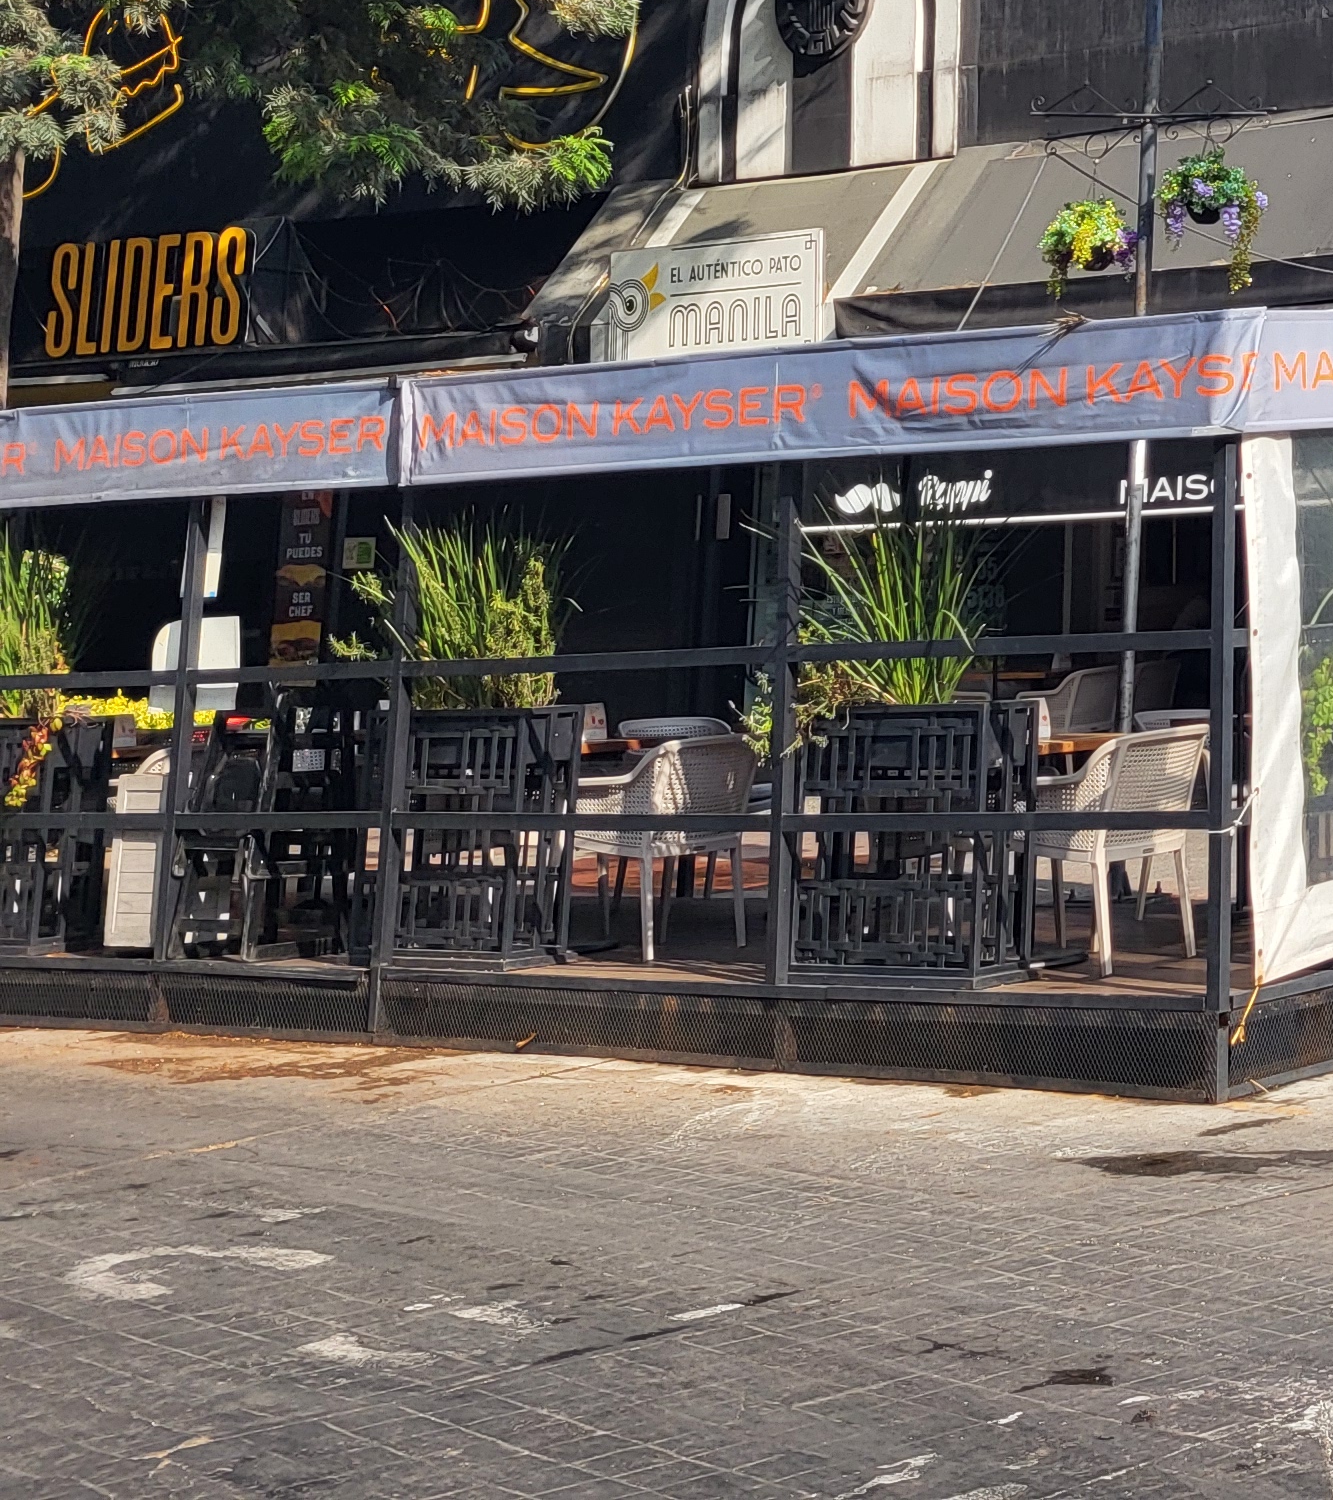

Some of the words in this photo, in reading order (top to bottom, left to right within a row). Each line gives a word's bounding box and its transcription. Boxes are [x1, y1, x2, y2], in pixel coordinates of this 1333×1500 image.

[45, 226, 247, 358] SLIDERS
[670, 266, 684, 284] EL
[688, 258, 764, 284] AUTÉNTICO
[768, 254, 802, 274] PATO
[668, 293, 801, 348] MANILA
[848, 366, 1068, 419] MAISON
[53, 426, 209, 474] MAISON
[220, 415, 386, 461] KAYSER
[419, 400, 599, 450] MAISON
[286, 546, 323, 560] PUEDES
[288, 605, 314, 618] CHEF
[292, 591, 311, 604] SER
